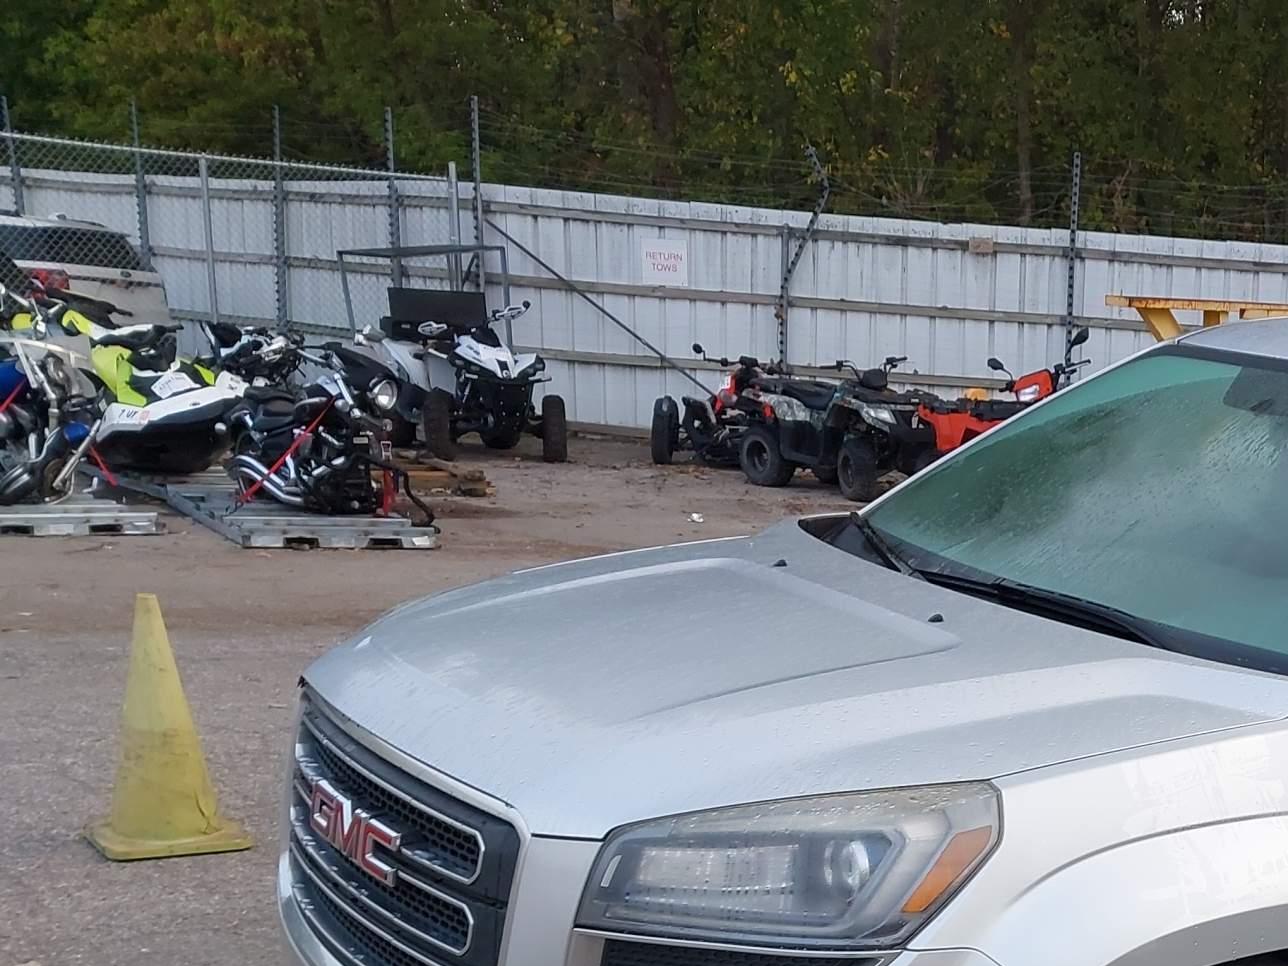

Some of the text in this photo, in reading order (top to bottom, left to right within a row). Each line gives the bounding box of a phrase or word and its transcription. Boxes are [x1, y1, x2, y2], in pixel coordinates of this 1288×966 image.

[645, 251, 683, 262] RETURN
[652, 263, 678, 273] TOWS
[310, 780, 401, 887] GMC
